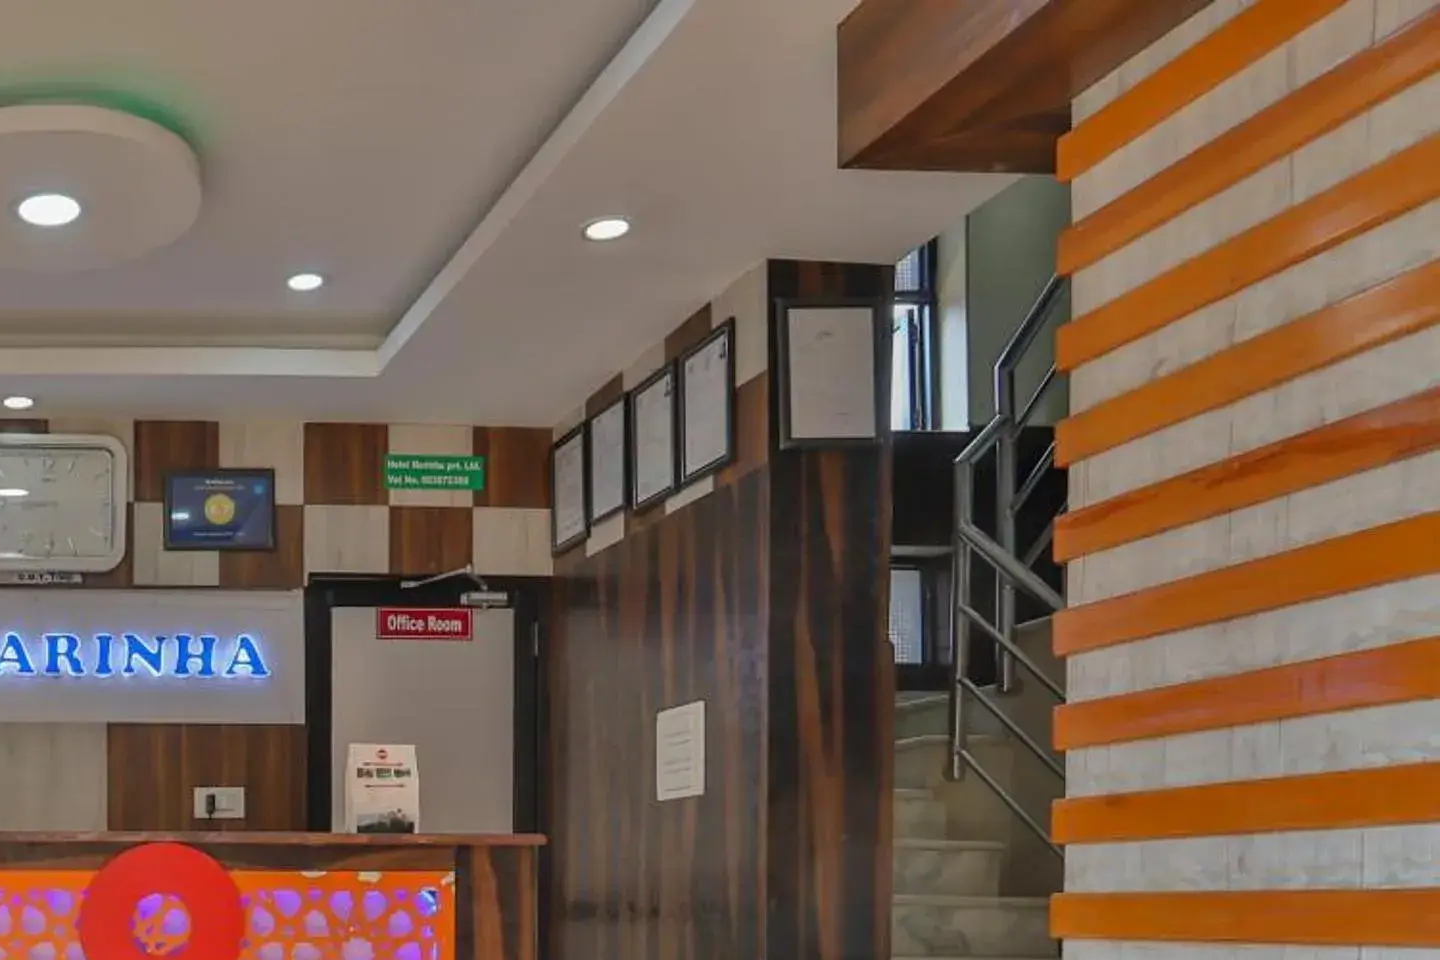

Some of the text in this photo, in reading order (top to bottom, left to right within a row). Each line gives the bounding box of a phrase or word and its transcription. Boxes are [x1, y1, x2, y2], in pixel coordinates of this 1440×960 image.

[388, 459, 410, 469] Hotel
[387, 613, 463, 633] Office Room
